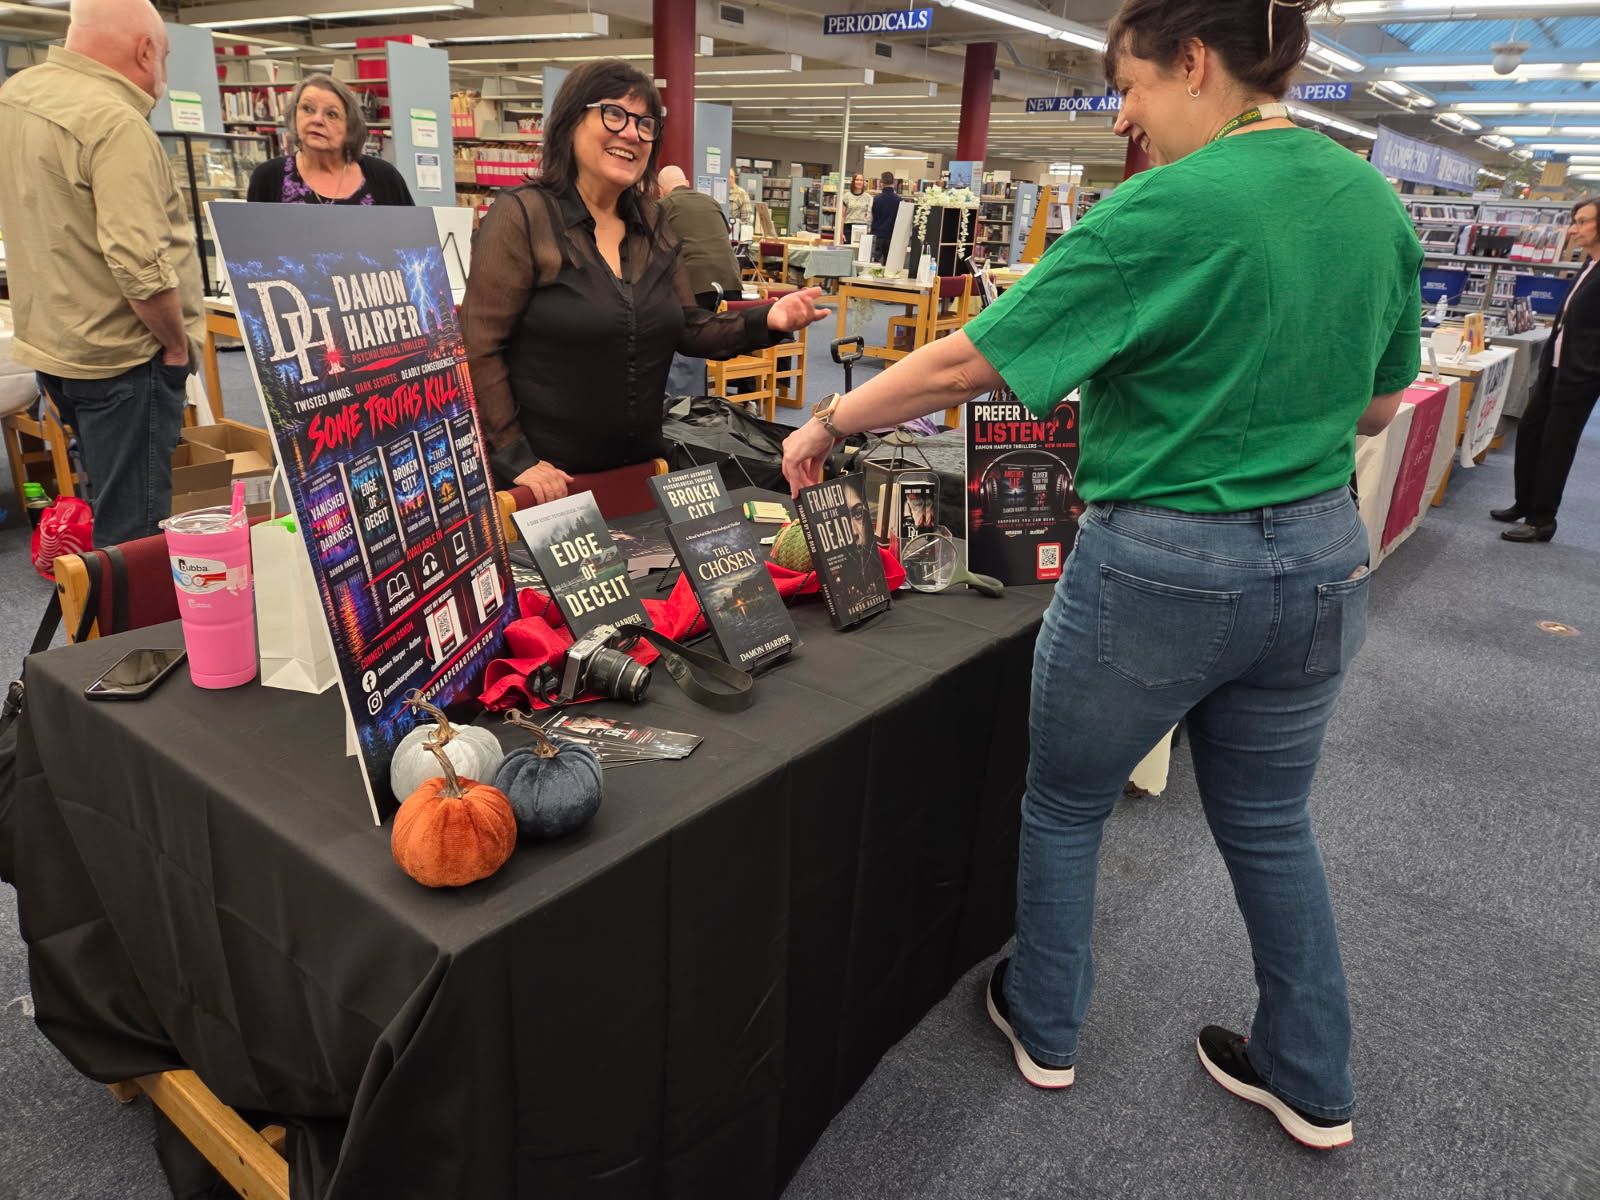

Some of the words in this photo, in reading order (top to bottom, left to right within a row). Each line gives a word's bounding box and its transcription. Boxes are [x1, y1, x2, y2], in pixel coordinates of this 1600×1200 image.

[828, 10, 928, 33] PERIODICALS
[1027, 98, 1057, 111] NEW
[1059, 97, 1093, 110] BOOK
[332, 269, 407, 313] DAMON
[343, 305, 422, 351] HARPER
[352, 345, 400, 364] PSYCHOLOGICAL
[400, 338, 428, 354] THRILLERS
[294, 393, 328, 413] TWISTED
[328, 387, 353, 404] MINDS.
[354, 378, 373, 394] DARK
[372, 373, 399, 391] SECRETS.
[401, 364, 421, 380] DEADLY
[421, 357, 455, 373] CONSEQUENCES.
[308, 402, 363, 465] SOME
[363, 383, 422, 440] TRUTHS
[974, 405, 1021, 421] PREFER
[454, 433, 473, 451] FRAMED
[975, 421, 1054, 442] LISTEN?
[429, 455, 453, 475] CHOSEN
[431, 447, 446, 461] THE
[392, 459, 419, 482] BROKEN
[461, 456, 478, 476] DEAD
[1032, 471, 1048, 479] CLOSER
[361, 478, 378, 497] EDGE
[401, 474, 418, 493] CITY
[663, 479, 695, 490] PSYCHOLOGICAL
[667, 481, 721, 508] BROKEN
[310, 492, 345, 521] VANISHED
[368, 495, 377, 510] OF
[687, 500, 716, 520] CITY
[806, 484, 845, 514] FRAMED
[325, 514, 340, 531] INTO
[365, 507, 389, 531] DECEIT
[829, 508, 839, 519] THE
[320, 523, 353, 552] DARKNESS
[370, 542, 384, 554] DAMON
[382, 533, 397, 546] HARPER
[405, 533, 436, 561] AVAILABLE
[435, 529, 444, 542] IN
[816, 516, 853, 552] DEAD
[550, 532, 603, 567] EDGE
[712, 545, 731, 557] THE
[178, 558, 208, 572] bubba
[329, 564, 344, 578] DAMON
[343, 555, 359, 569] HARPER
[581, 563, 597, 580] OF
[699, 548, 757, 580] CHOSEN
[389, 591, 415, 616] PAPERBACK
[564, 574, 631, 618] DECEIT
[615, 612, 642, 628] HARPER
[361, 646, 385, 670] CONNECT
[384, 638, 396, 652] WITH
[739, 644, 765, 662] DAMON
[764, 634, 791, 650] HARPER
[377, 660, 393, 677] Damon
